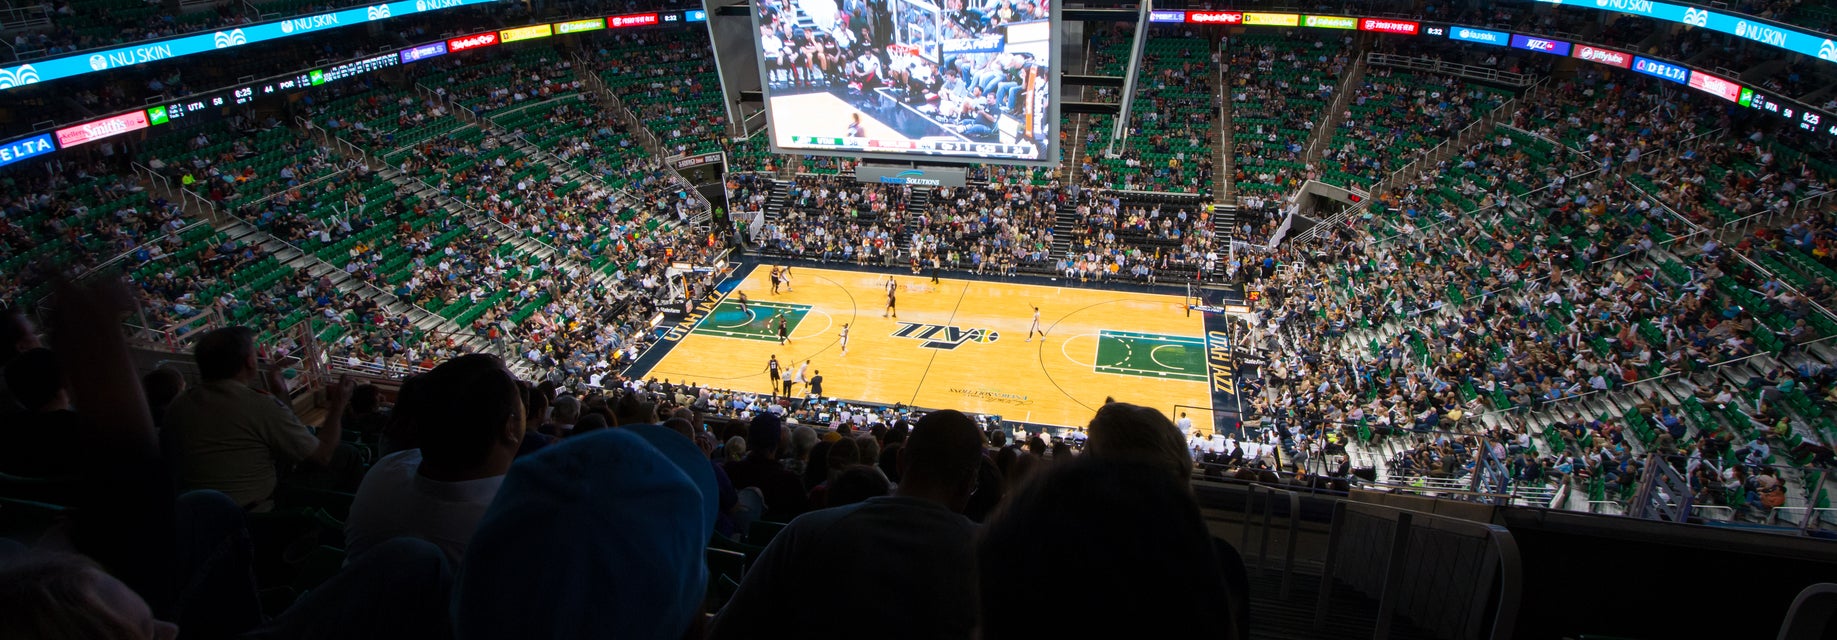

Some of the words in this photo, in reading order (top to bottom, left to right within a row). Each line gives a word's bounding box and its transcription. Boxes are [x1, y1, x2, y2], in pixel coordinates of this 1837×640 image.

[1628, 0, 1653, 13] SKIN
[294, 19, 313, 30] NU
[314, 13, 338, 28] SKIN
[1746, 24, 1762, 40] NU
[1762, 28, 1787, 48] SKIN
[108, 50, 135, 68] NU
[136, 44, 172, 63] SKIN
[1647, 62, 1686, 82] DELTA
[188, 101, 205, 111] UTA
[212, 97, 223, 106] 58
[234, 87, 252, 98] 6:25
[264, 85, 274, 94] 44
[279, 80, 294, 90] POR
[1765, 101, 1778, 113] UTA
[1783, 108, 1793, 118] 58
[1802, 112, 1820, 125] 6:25
[663, 313, 703, 341] UTAH
[1208, 330, 1231, 362] UTAH
[1208, 361, 1235, 395] JAZZ
